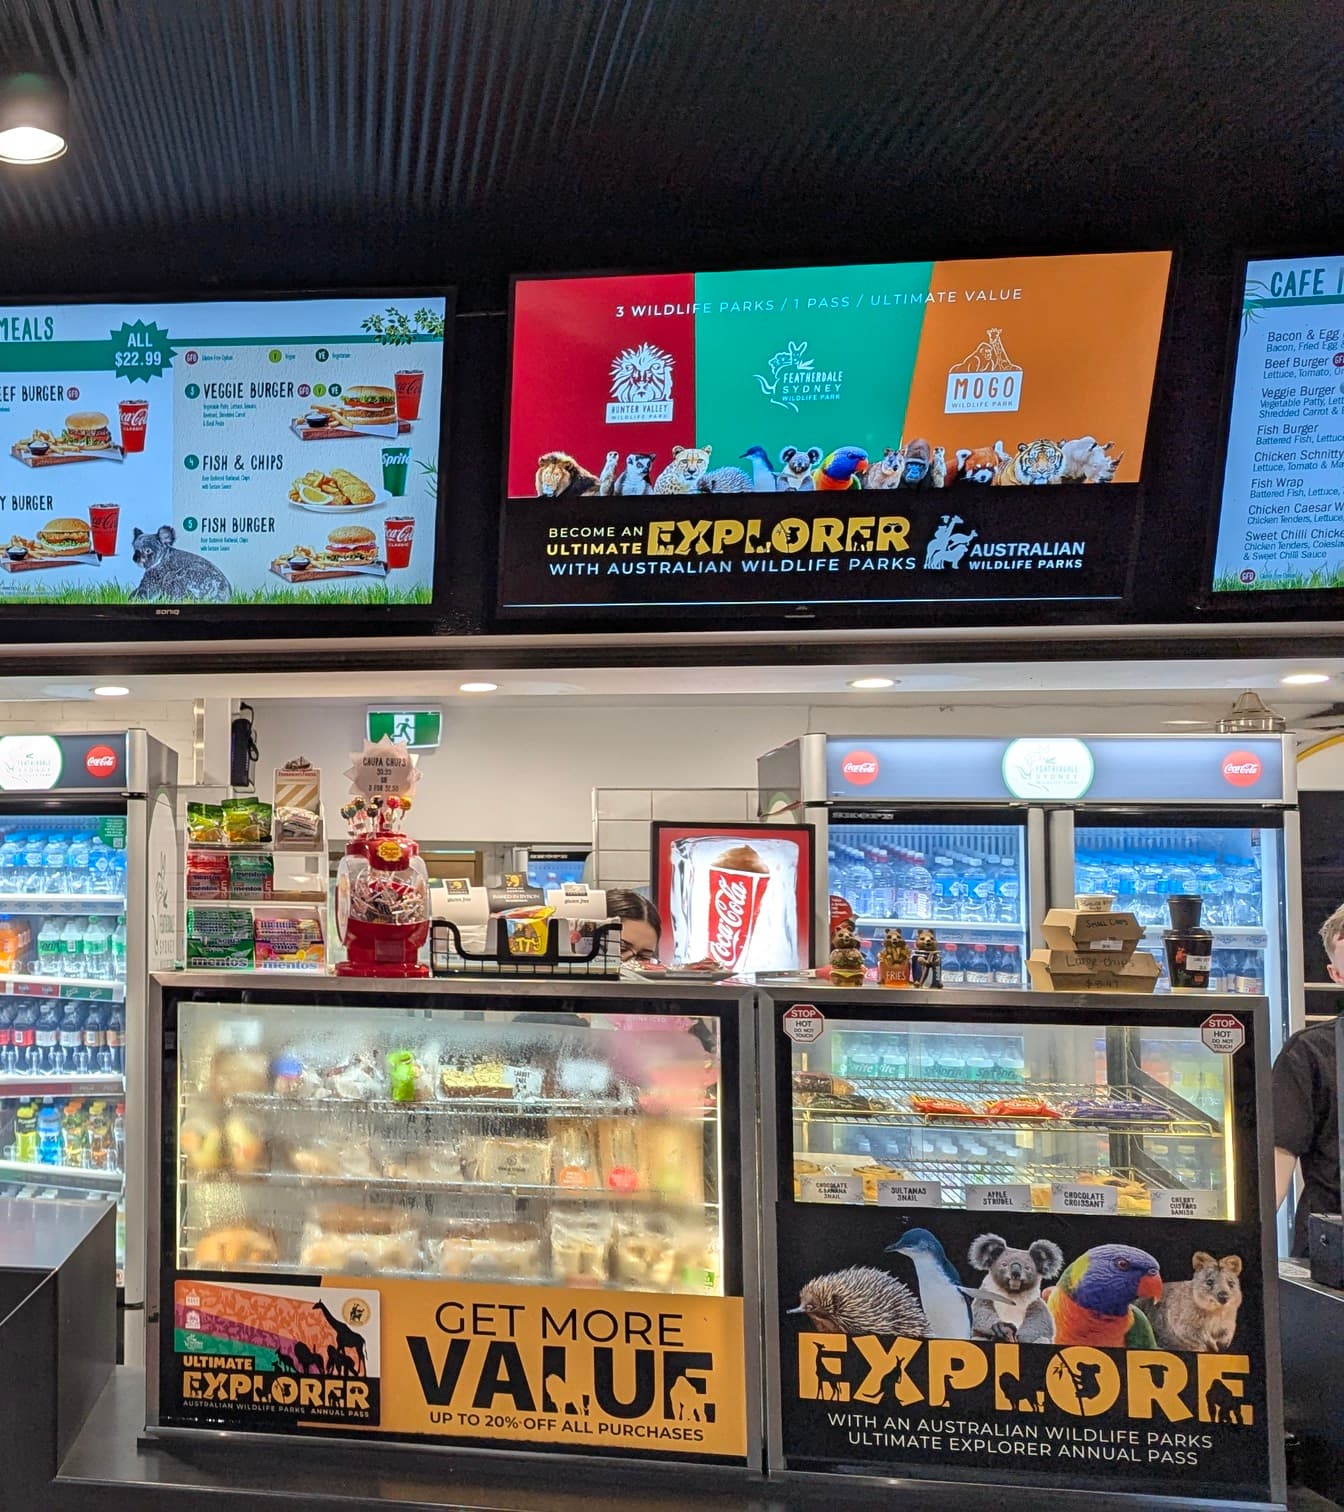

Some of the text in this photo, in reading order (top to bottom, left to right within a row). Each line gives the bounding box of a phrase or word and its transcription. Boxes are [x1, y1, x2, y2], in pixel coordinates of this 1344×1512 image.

[1270, 269, 1325, 297] CAFE
[616, 288, 1023, 317] 3 WILDLIFE PARKS 1 PASS ULTIMATE VALUE
[128, 332, 152, 348] ALL
[1267, 328, 1340, 342] Bacon & Egg
[115, 352, 162, 368] $22.99
[1265, 356, 1329, 369] Beef Burger
[783, 370, 843, 383] FEATHERDALE
[22, 385, 64, 401] BURGER
[204, 382, 294, 399] VEGGIE BURGER
[782, 383, 842, 394] SYDNEY
[953, 375, 1015, 400] MOGO
[1261, 385, 1336, 400] Veggie Burger
[612, 404, 668, 414] HUNTER VALLEY
[952, 401, 990, 409] WILDLIFE
[1257, 424, 1319, 435] Fish Burger
[202, 454, 284, 470] FISH & CHIPS
[1254, 449, 1344, 462] Chicken Schnitty
[1251, 478, 1304, 489] Fish Wrap
[12, 495, 53, 511] BURGER
[1248, 503, 1332, 516] Chicken Caesar
[201, 517, 275, 533] FISH BURGER
[549, 526, 644, 538] BECOME AN
[647, 515, 911, 556] EXPLORER
[1245, 529, 1306, 542] Sweet Chilli
[546, 542, 642, 556] ULTIMATE
[969, 541, 1086, 557] AUSTRALIAN
[549, 557, 916, 576] WITH AUSTRALIAN WILDLIFE PARKS
[968, 558, 1083, 570] WILDLIFE PARKS
[87, 756, 115, 767] Coca-Cola
[844, 762, 876, 774] Coca-Cola
[1224, 763, 1258, 775] Coca-Cola
[710, 874, 748, 971] Coca-Cola
[192, 957, 248, 967] mentos
[263, 960, 317, 969] mentos
[886, 971, 906, 980] FRIES
[891, 1187, 927, 1195] SULTANAS
[1064, 1192, 1104, 1200] CHOCOLATE
[1064, 1200, 1104, 1208] CROISSANT
[435, 1301, 684, 1347] GET MORE
[183, 1355, 253, 1370] ULTIMATE
[406, 1335, 716, 1424] VALUE
[797, 1331, 1254, 1426] EXPLORE
[183, 1371, 370, 1409] EXPLORER
[183, 1400, 370, 1418] AUSTRALIAN WILDLIFE PARKS ANNUAL PASS
[430, 1411, 704, 1442] UP TO 20% OFF ALL PURCHASES
[827, 1412, 1213, 1450] WITH AN AUSTRALIAN WILDLIFE PARKS
[848, 1430, 1199, 1466] ULTIMATE EXPLORER ANNUAL PASS
